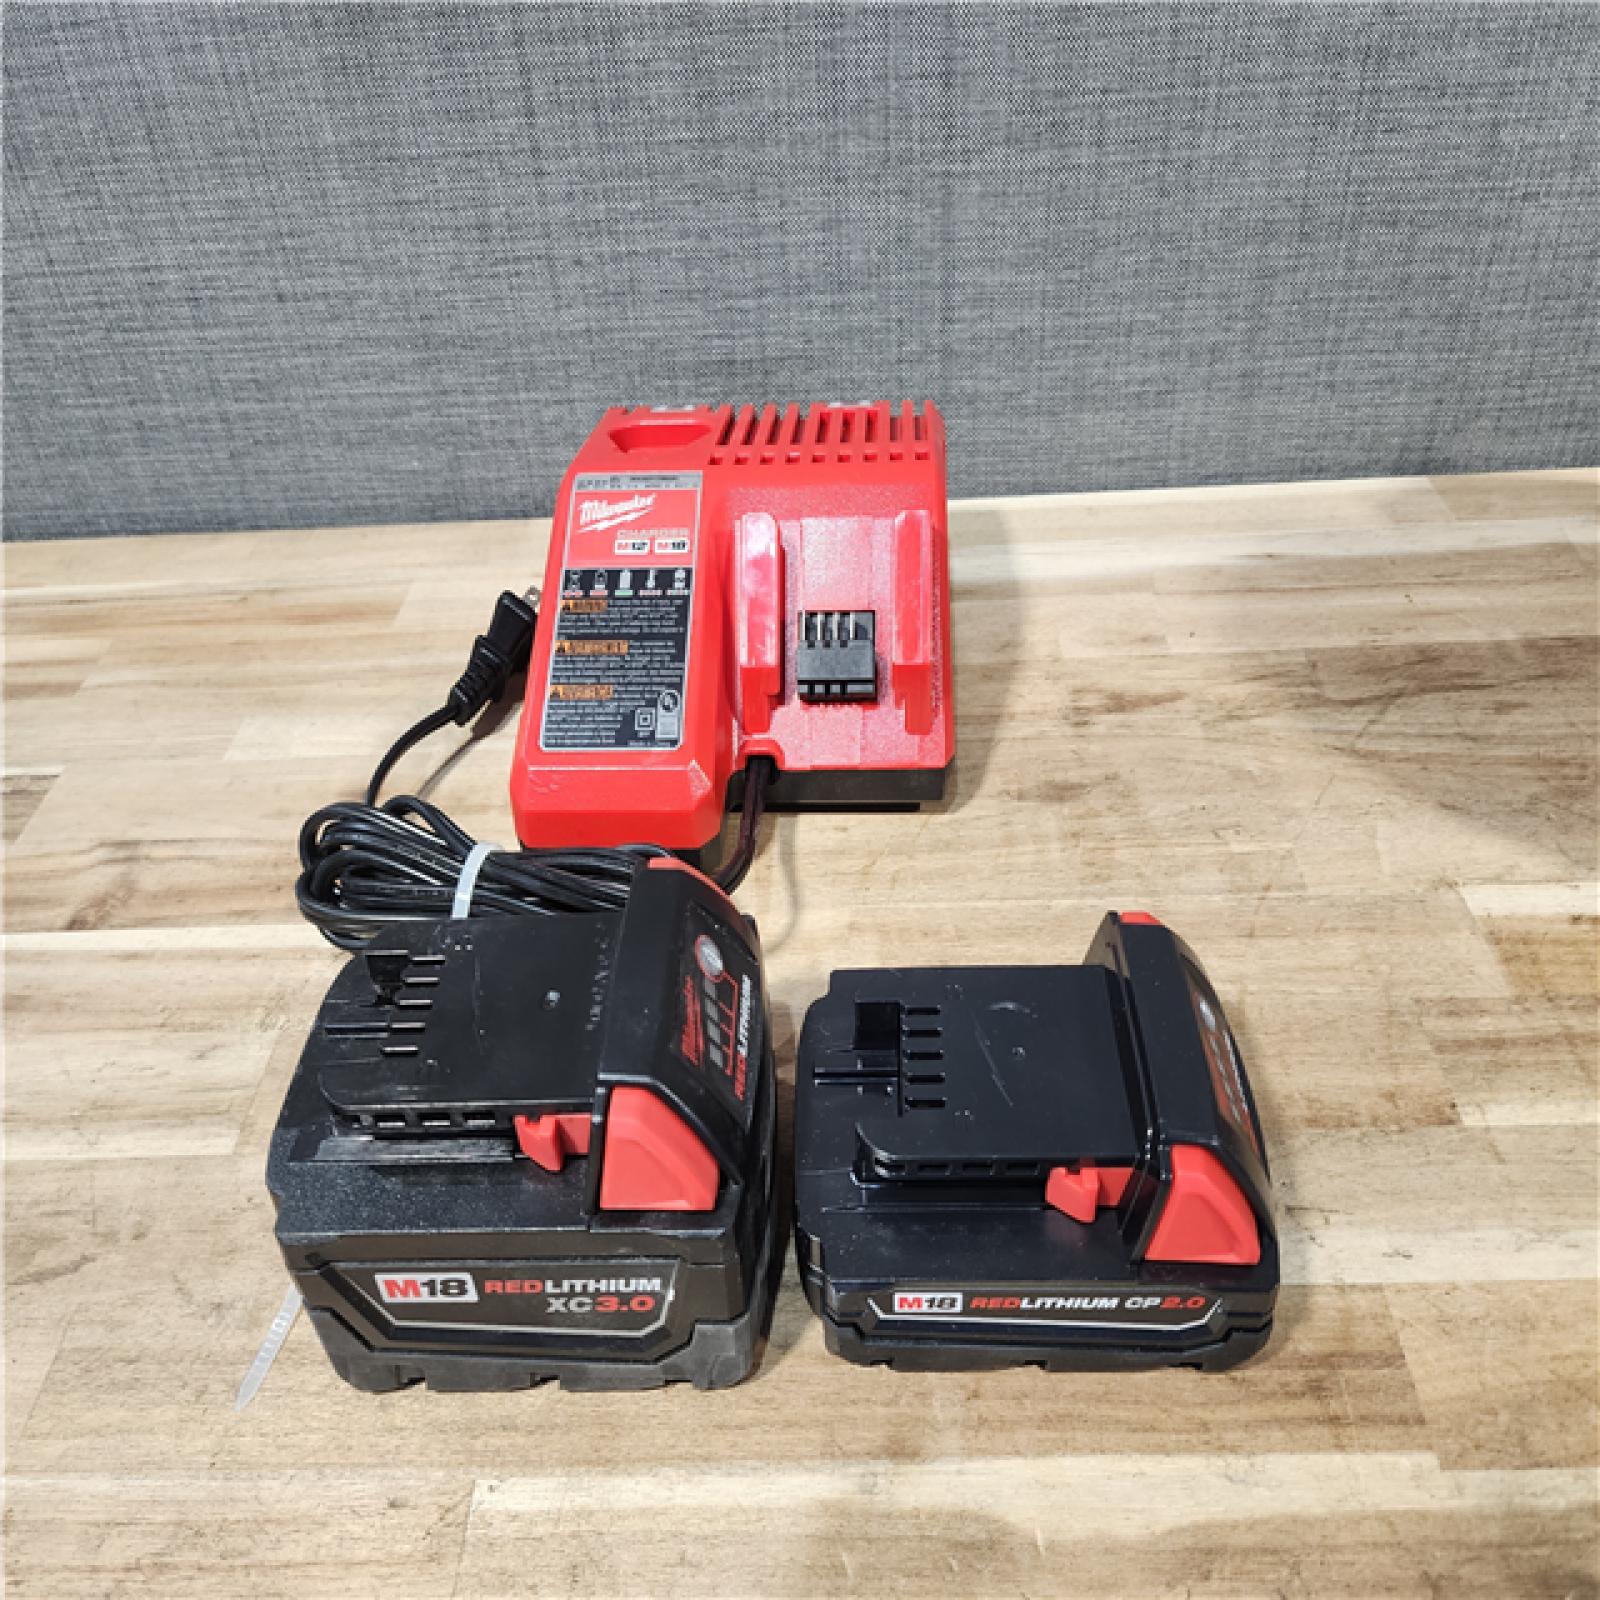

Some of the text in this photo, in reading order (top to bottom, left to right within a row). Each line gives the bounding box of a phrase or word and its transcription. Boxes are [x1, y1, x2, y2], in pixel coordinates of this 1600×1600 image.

[383, 1278, 661, 1299] M18 REDLITHIUM
[546, 1296, 656, 1314] XC3.0
[897, 1295, 1207, 1310] M18 REDLITHIUM CP2.0
